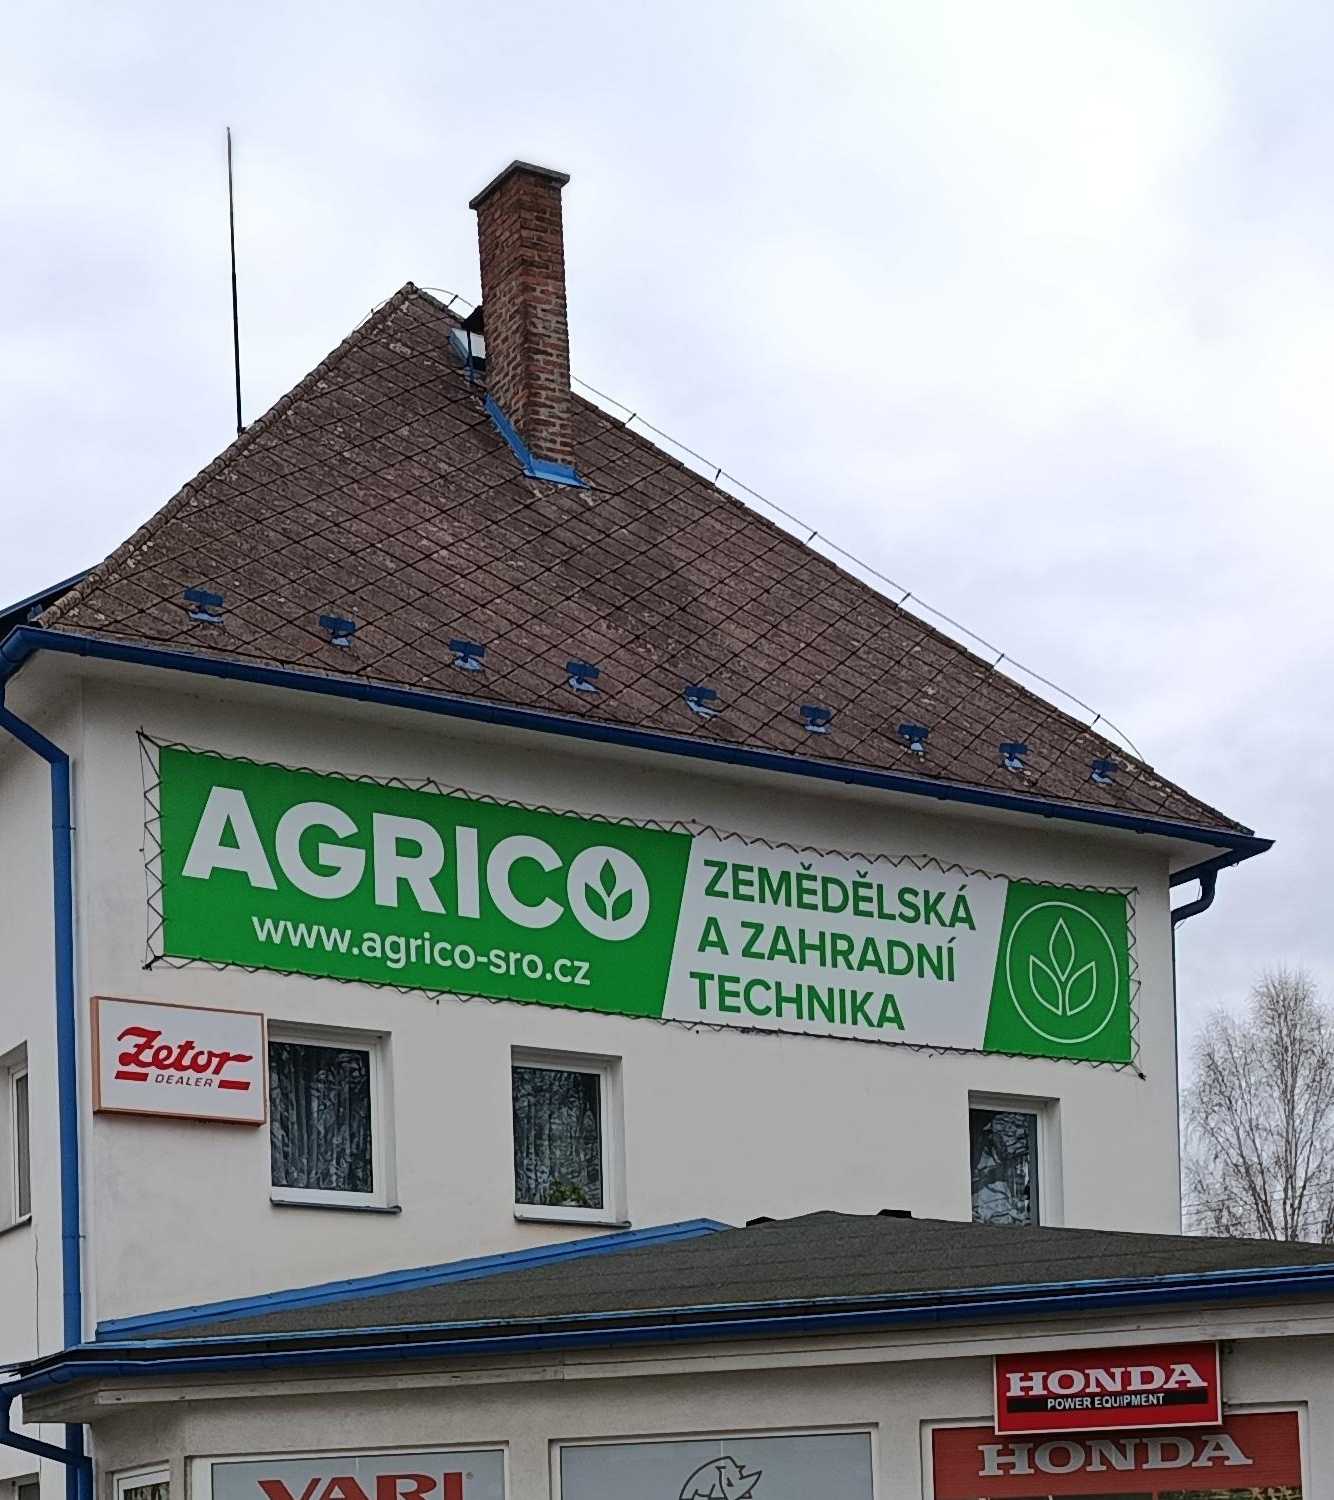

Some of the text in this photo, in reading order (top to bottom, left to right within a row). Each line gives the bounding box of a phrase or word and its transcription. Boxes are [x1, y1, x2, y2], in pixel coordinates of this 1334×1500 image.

[182, 786, 650, 941] AGRICO
[703, 860, 976, 931] ZEMĚDĚLSKÁ
[252, 916, 590, 985] www.agrico-sro.cz
[698, 917, 955, 982] A ZAHRADNÍ
[690, 971, 905, 1031] TECHNIKA
[117, 1027, 253, 1075] Zetor
[155, 1073, 213, 1089] DEALER
[1005, 1363, 1208, 1397] HONDA
[1047, 1393, 1165, 1410] POWER EQUIPMENT
[977, 1434, 1253, 1476] HONDA
